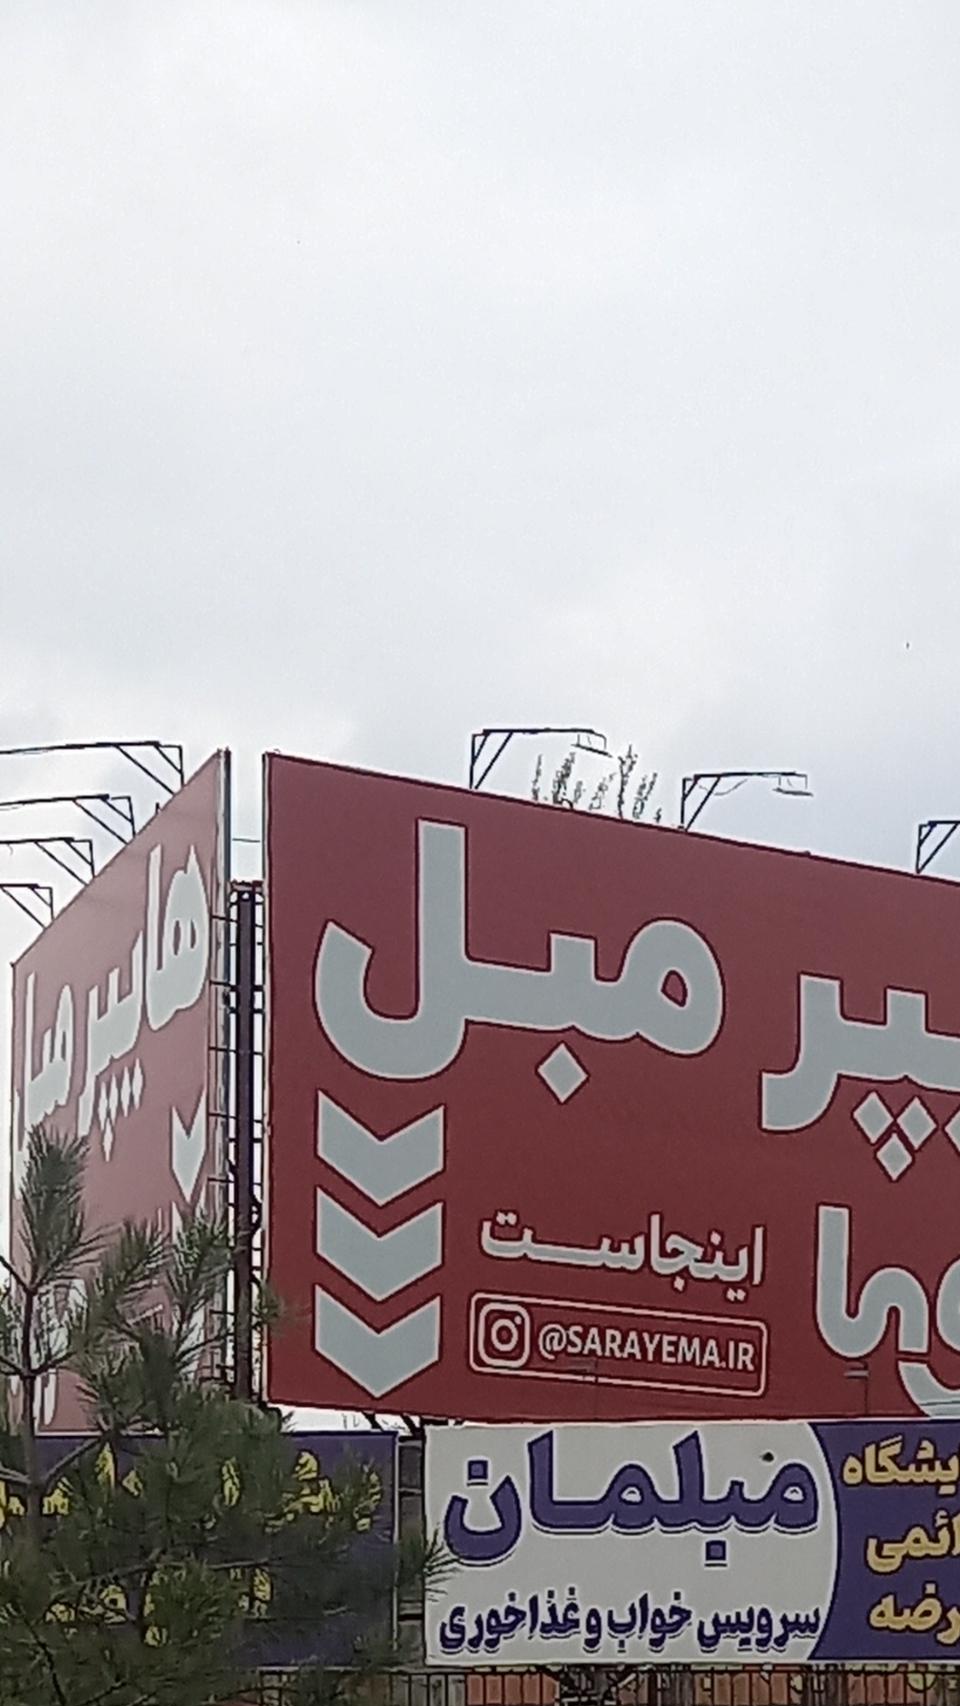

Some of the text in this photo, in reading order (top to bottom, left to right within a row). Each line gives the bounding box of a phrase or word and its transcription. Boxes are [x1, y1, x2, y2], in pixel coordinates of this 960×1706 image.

[314, 816, 727, 1105] مبل
[77, 843, 211, 1163] هایپر
[480, 1211, 766, 1302] اینجاست
[538, 1322, 756, 1373] @SARAYEMA.IR
[443, 1430, 820, 1569] مبلمان
[582, 1604, 602, 1653] و
[606, 1590, 693, 1654] خواب
[697, 1604, 822, 1654] سرویس
